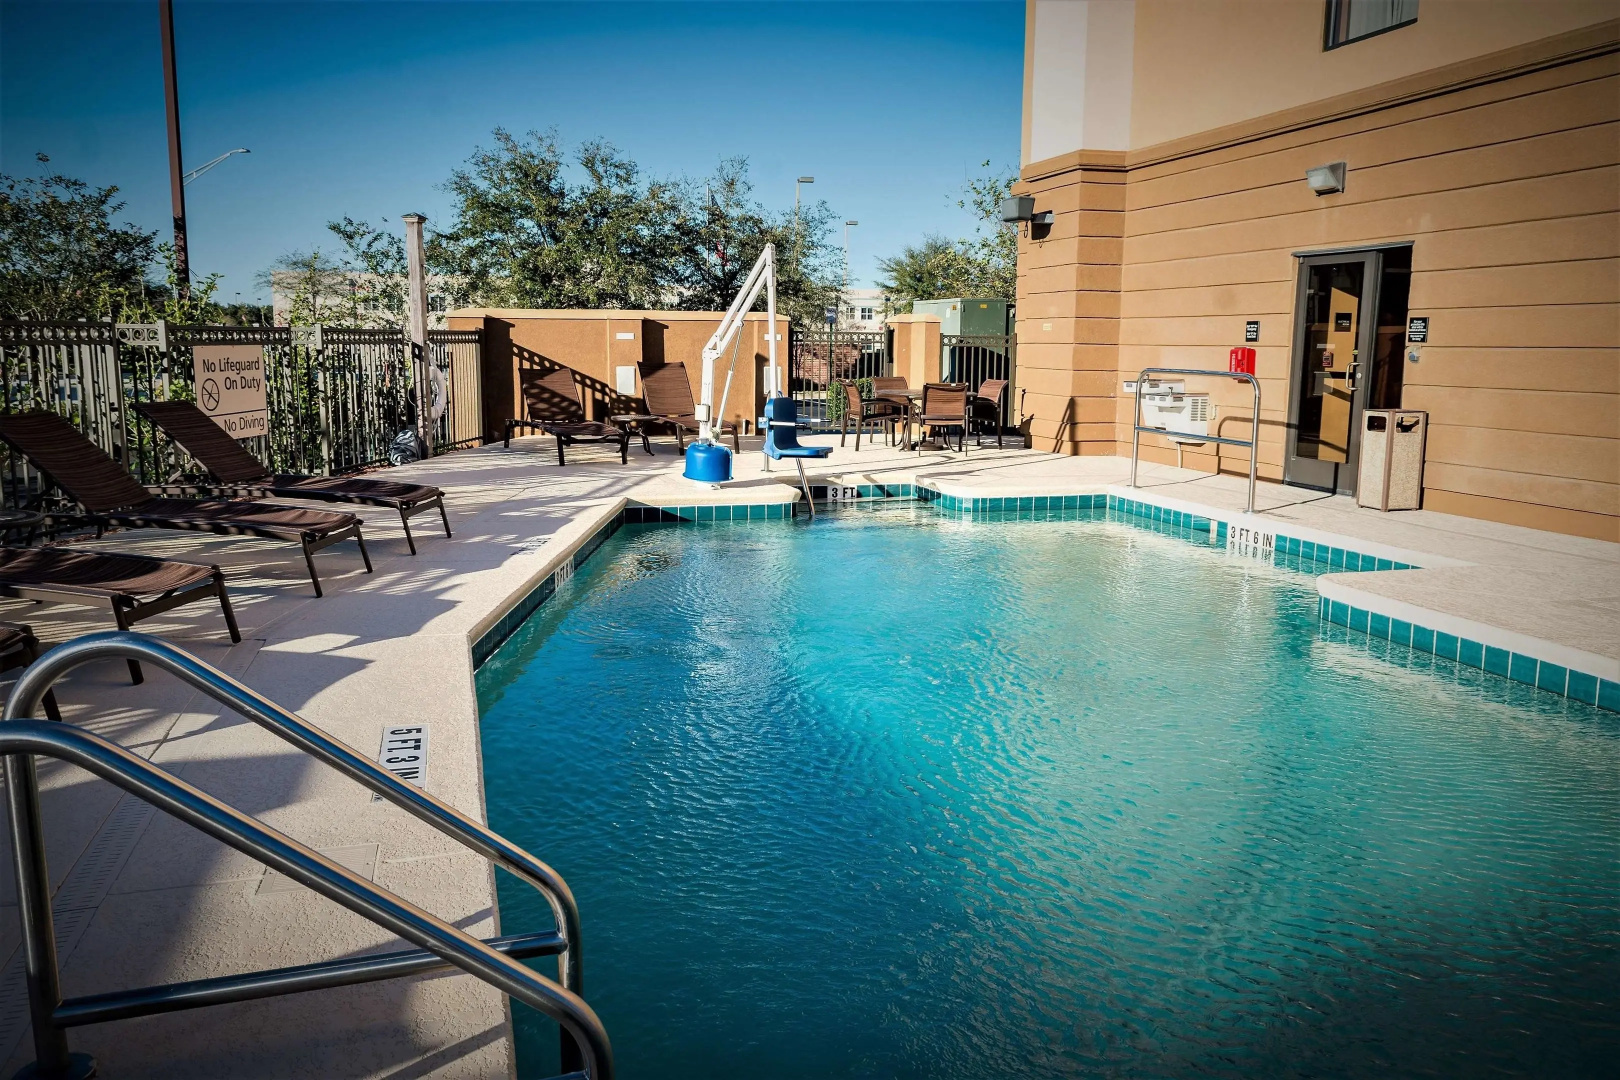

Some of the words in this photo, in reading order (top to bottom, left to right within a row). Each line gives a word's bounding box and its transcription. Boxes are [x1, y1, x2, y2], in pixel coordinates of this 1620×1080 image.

[202, 359, 217, 373] No
[219, 357, 260, 375] Lifeguard
[224, 376, 238, 390] On
[240, 376, 261, 392] Duty
[224, 419, 237, 432] No
[239, 415, 264, 431] Diving
[831, 487, 838, 498] 3
[1230, 526, 1236, 539] 3
[1253, 531, 1259, 544] 6
